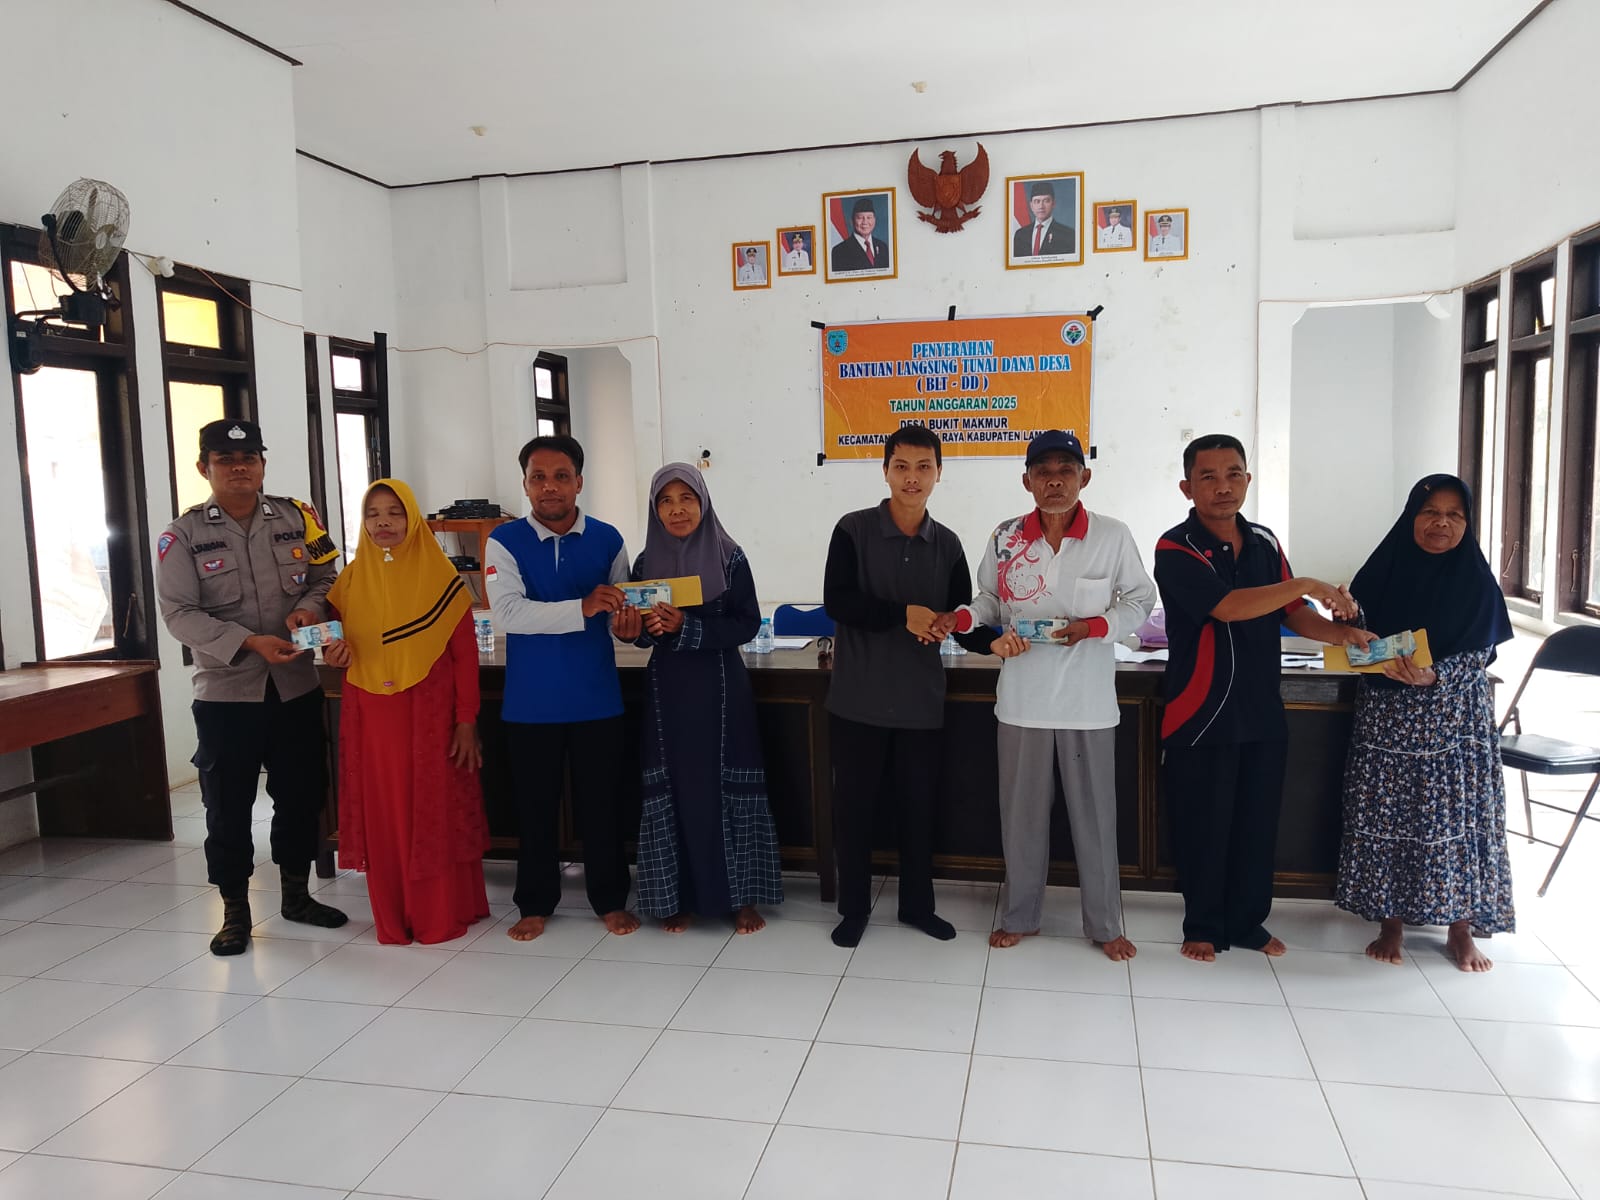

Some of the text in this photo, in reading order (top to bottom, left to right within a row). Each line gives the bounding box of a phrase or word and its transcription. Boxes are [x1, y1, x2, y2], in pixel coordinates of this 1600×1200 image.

[912, 340, 993, 358] PENYERAHAN
[839, 354, 1071, 379] BANTUAN LANGSUNG TUNAI DANA DESA
[925, 376, 948, 392] BLT
[960, 375, 979, 391] DD
[889, 396, 1017, 412] TAHUN ANGGARAN 2025
[928, 418, 960, 431] BUKIT
[962, 417, 1008, 430] MAKMUR
[838, 433, 892, 445] KECAMATAN
[942, 431, 964, 443] RAYA
[967, 430, 1020, 442] KABUPATEN
